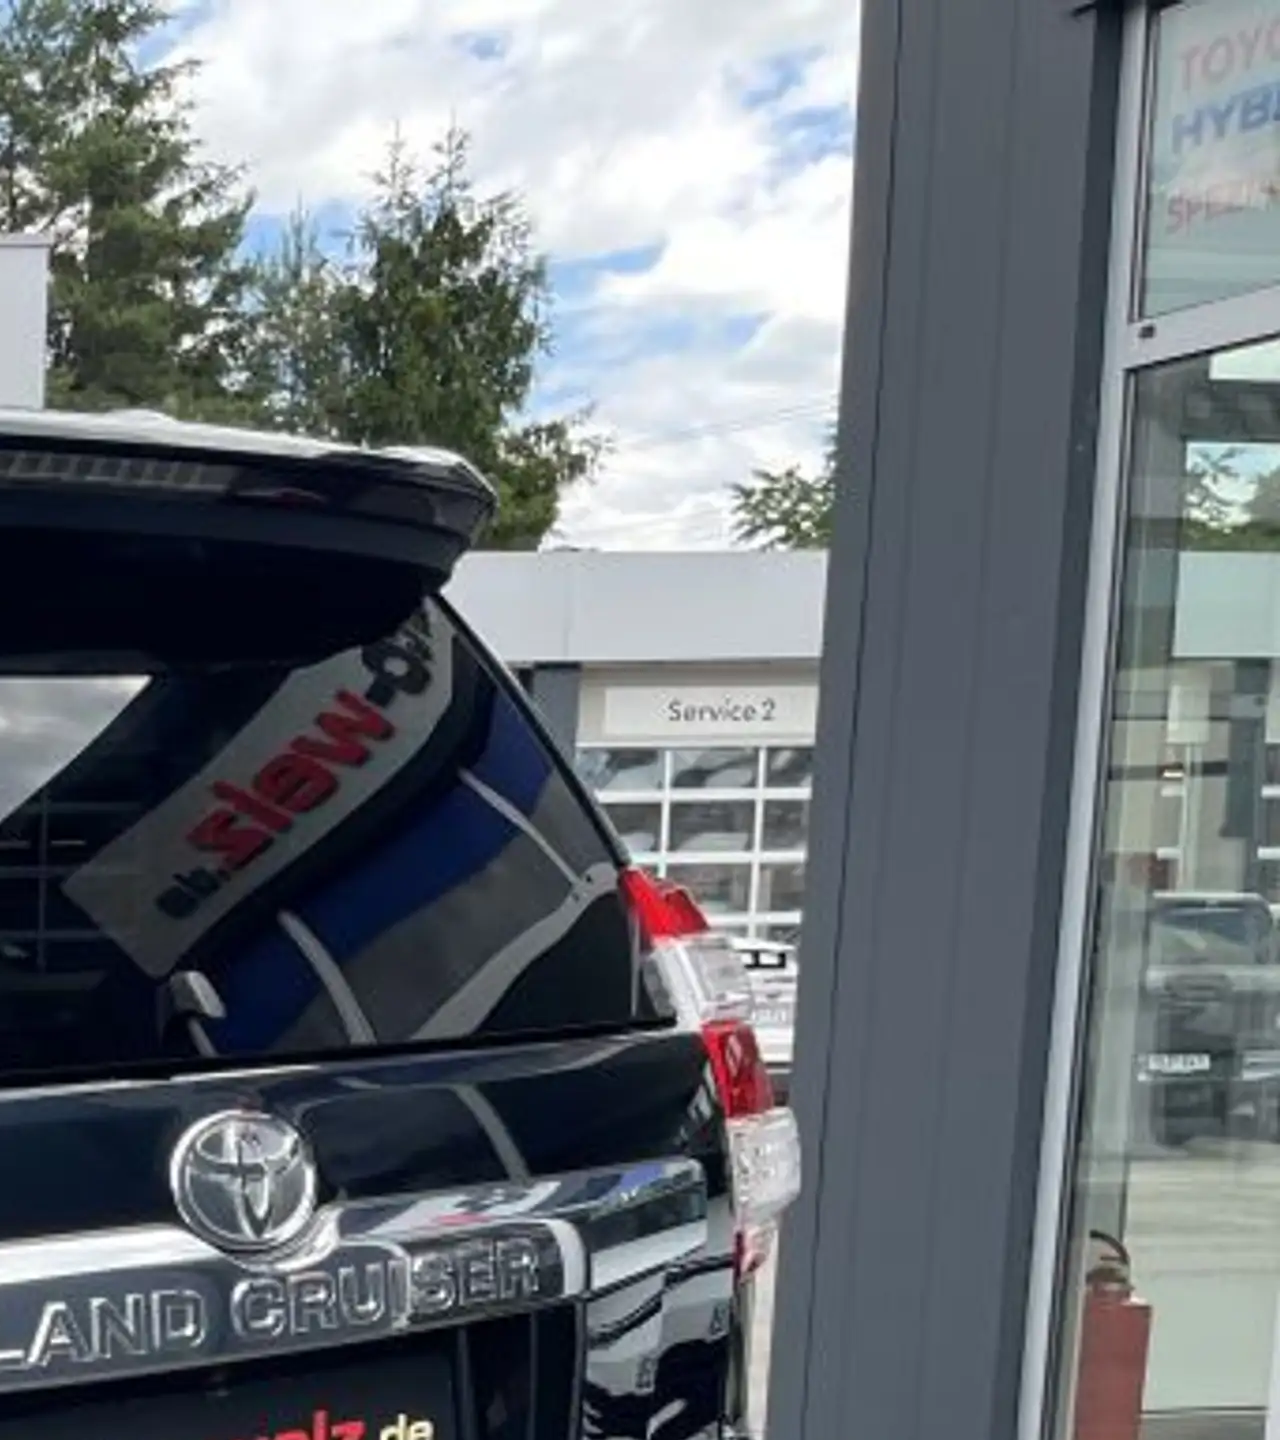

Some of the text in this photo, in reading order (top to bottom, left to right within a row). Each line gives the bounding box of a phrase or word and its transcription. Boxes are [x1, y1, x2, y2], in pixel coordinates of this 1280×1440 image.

[1172, 82, 1280, 153] HYB
[668, 696, 776, 722] Service 2
[230, 1235, 542, 1340] CRUISER
